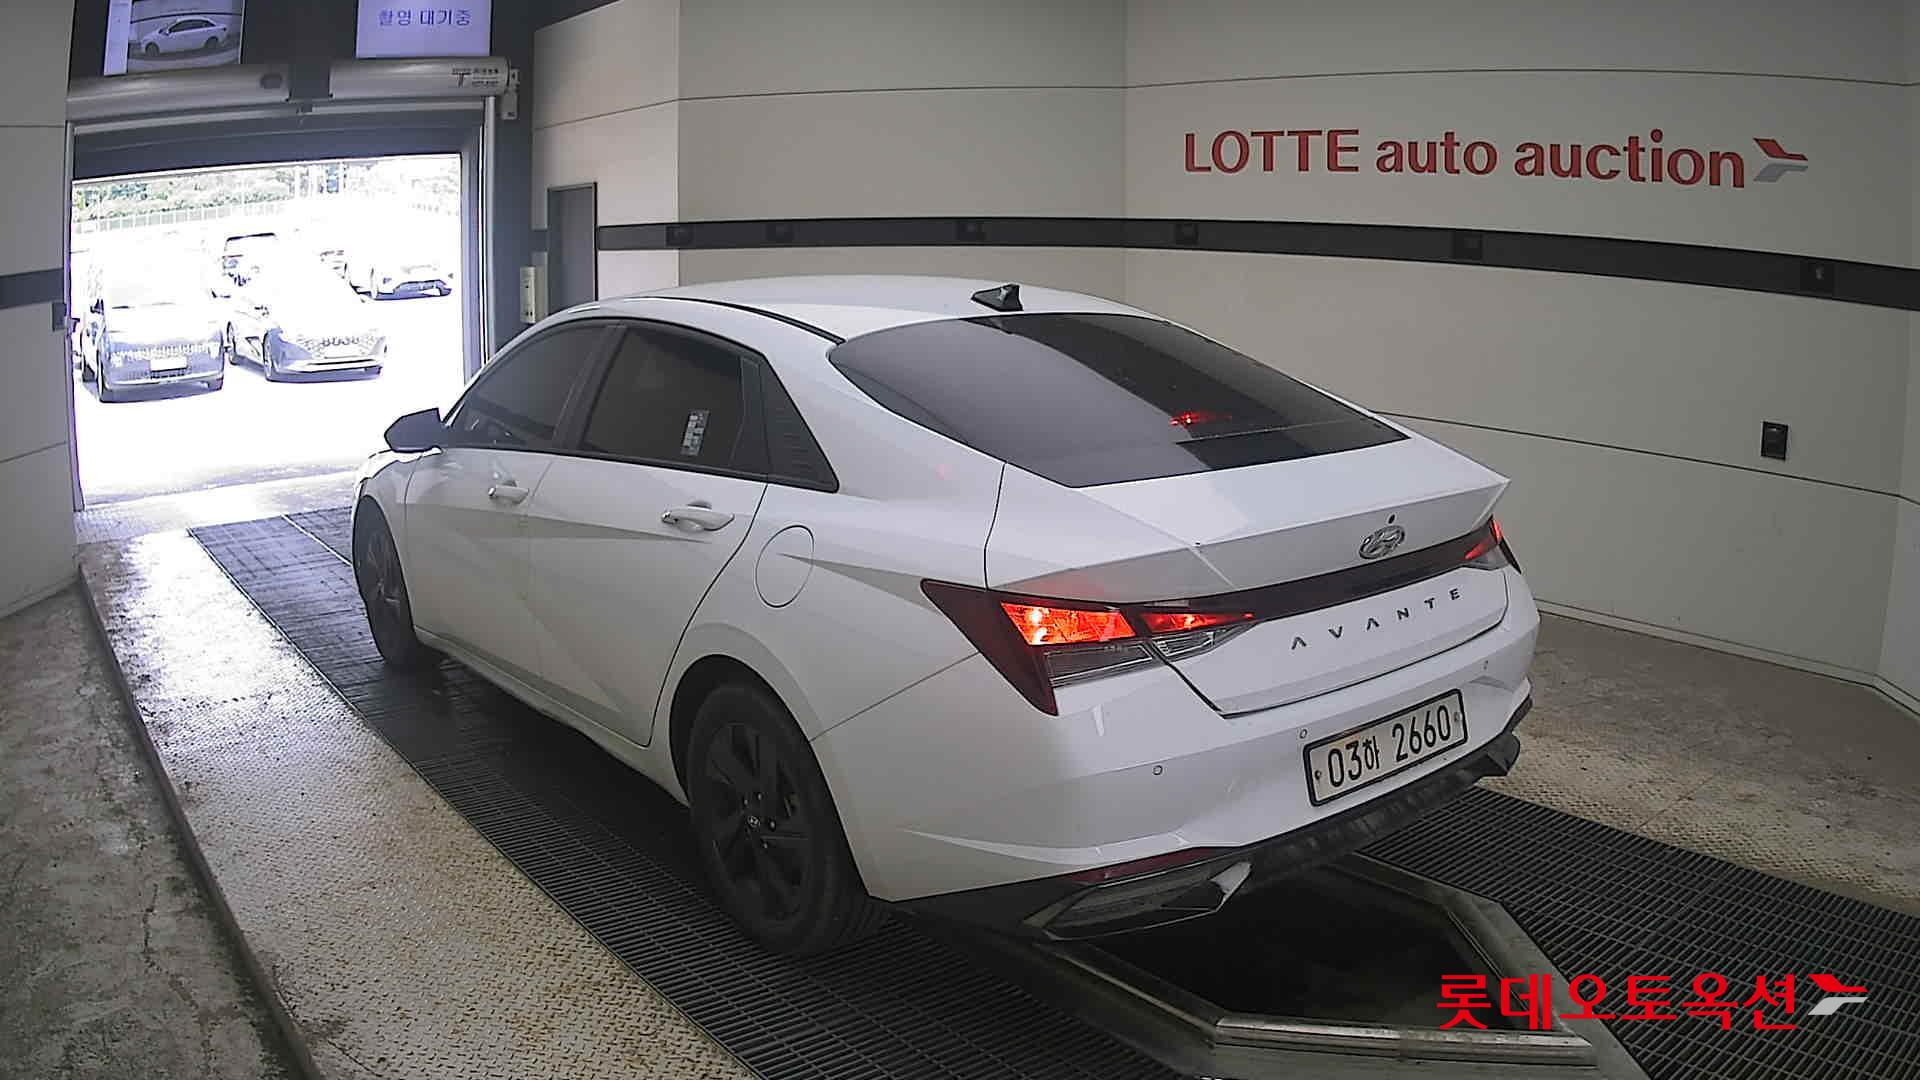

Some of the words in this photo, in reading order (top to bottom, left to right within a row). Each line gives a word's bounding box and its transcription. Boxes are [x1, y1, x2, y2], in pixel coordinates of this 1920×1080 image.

[420, 9, 471, 26] 대기중
[1184, 129, 1360, 174] LOTTE
[1376, 130, 1498, 175] auto
[1515, 128, 1745, 188] auction
[1291, 588, 1461, 650] AVANTE
[1328, 736, 1380, 788] 03하
[1391, 704, 1451, 763] 2660
